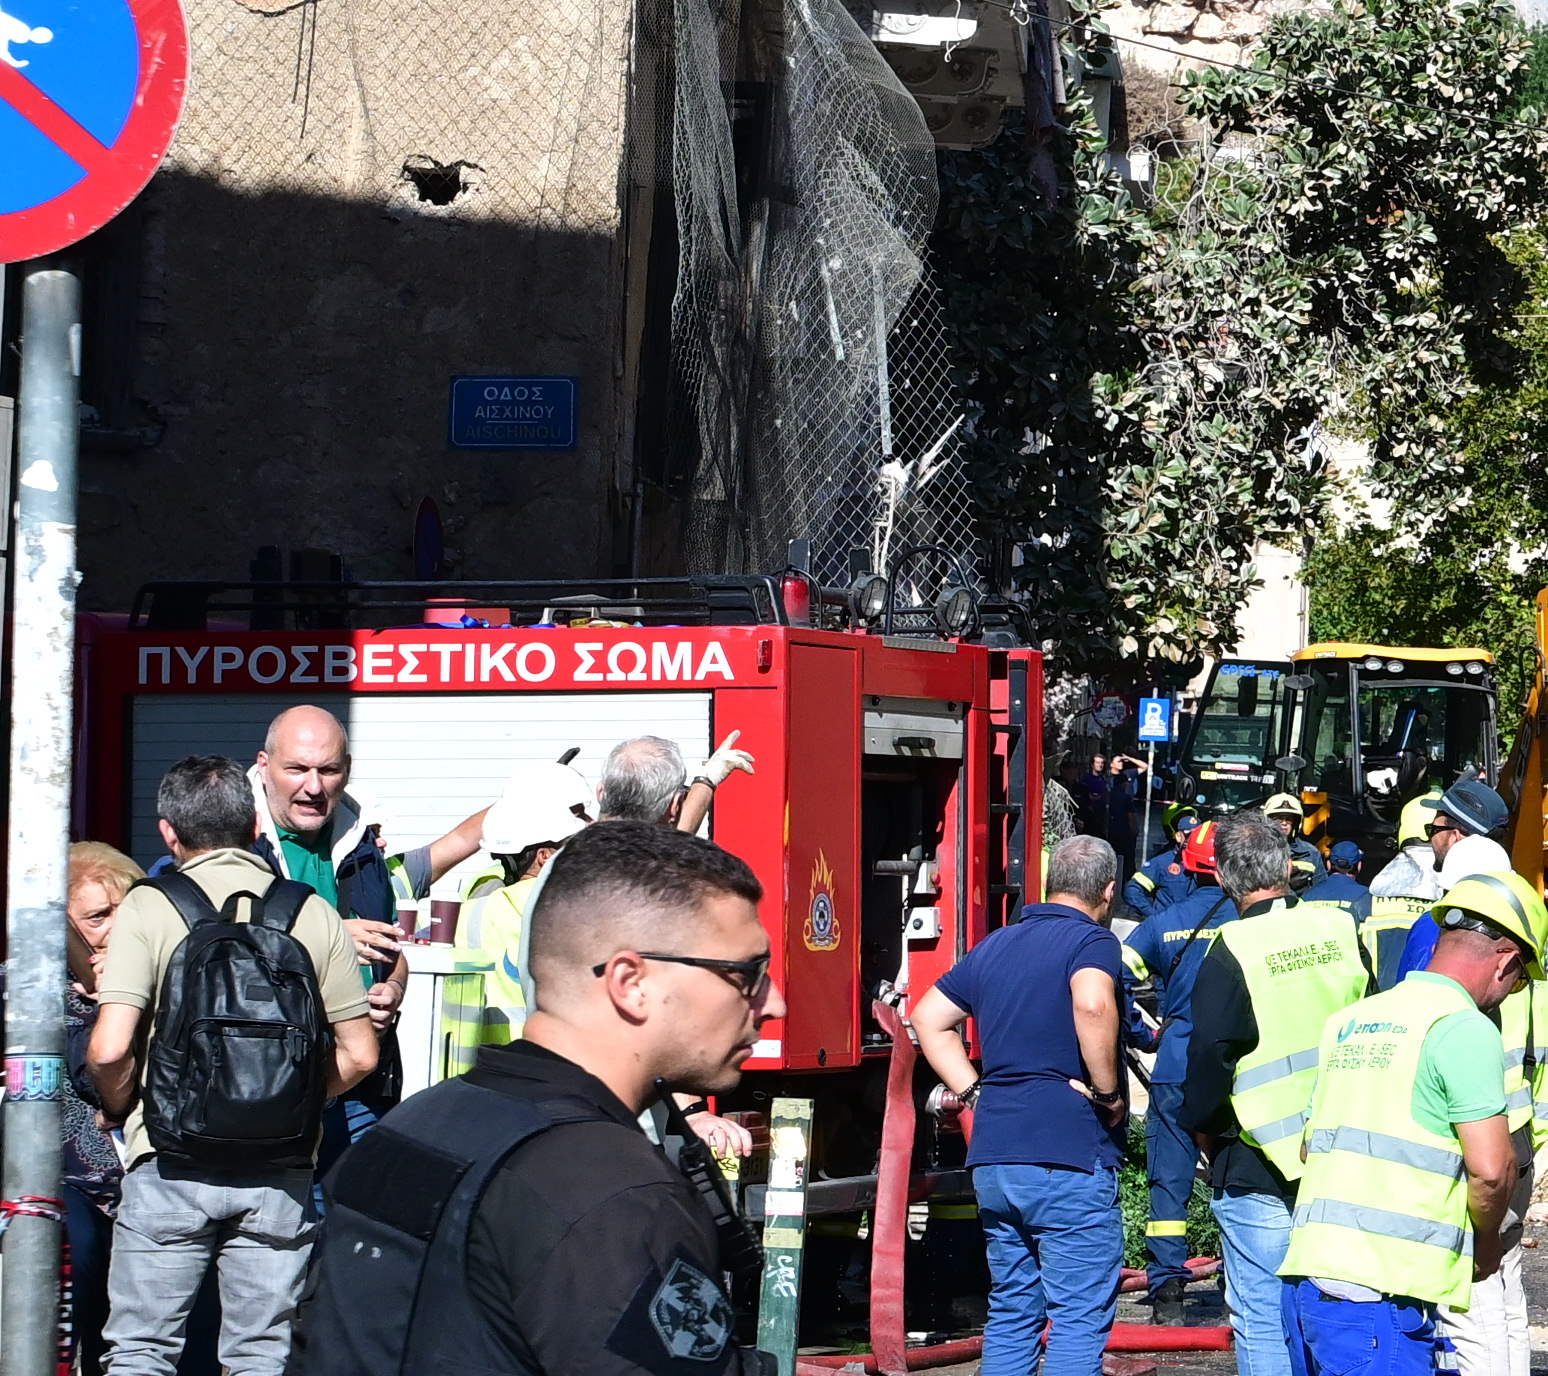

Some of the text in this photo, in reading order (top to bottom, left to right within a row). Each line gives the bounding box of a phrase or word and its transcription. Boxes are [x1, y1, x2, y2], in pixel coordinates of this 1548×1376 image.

[483, 386, 544, 401] ΟΔΟΣ
[474, 405, 555, 419] ΑΙΣΧΙΝΟΥ
[465, 425, 561, 439] AISCHINOU
[138, 640, 736, 685] ΠΥΡΟΣΒΕΣΤΙΚΟ ΣΩΜΑ
